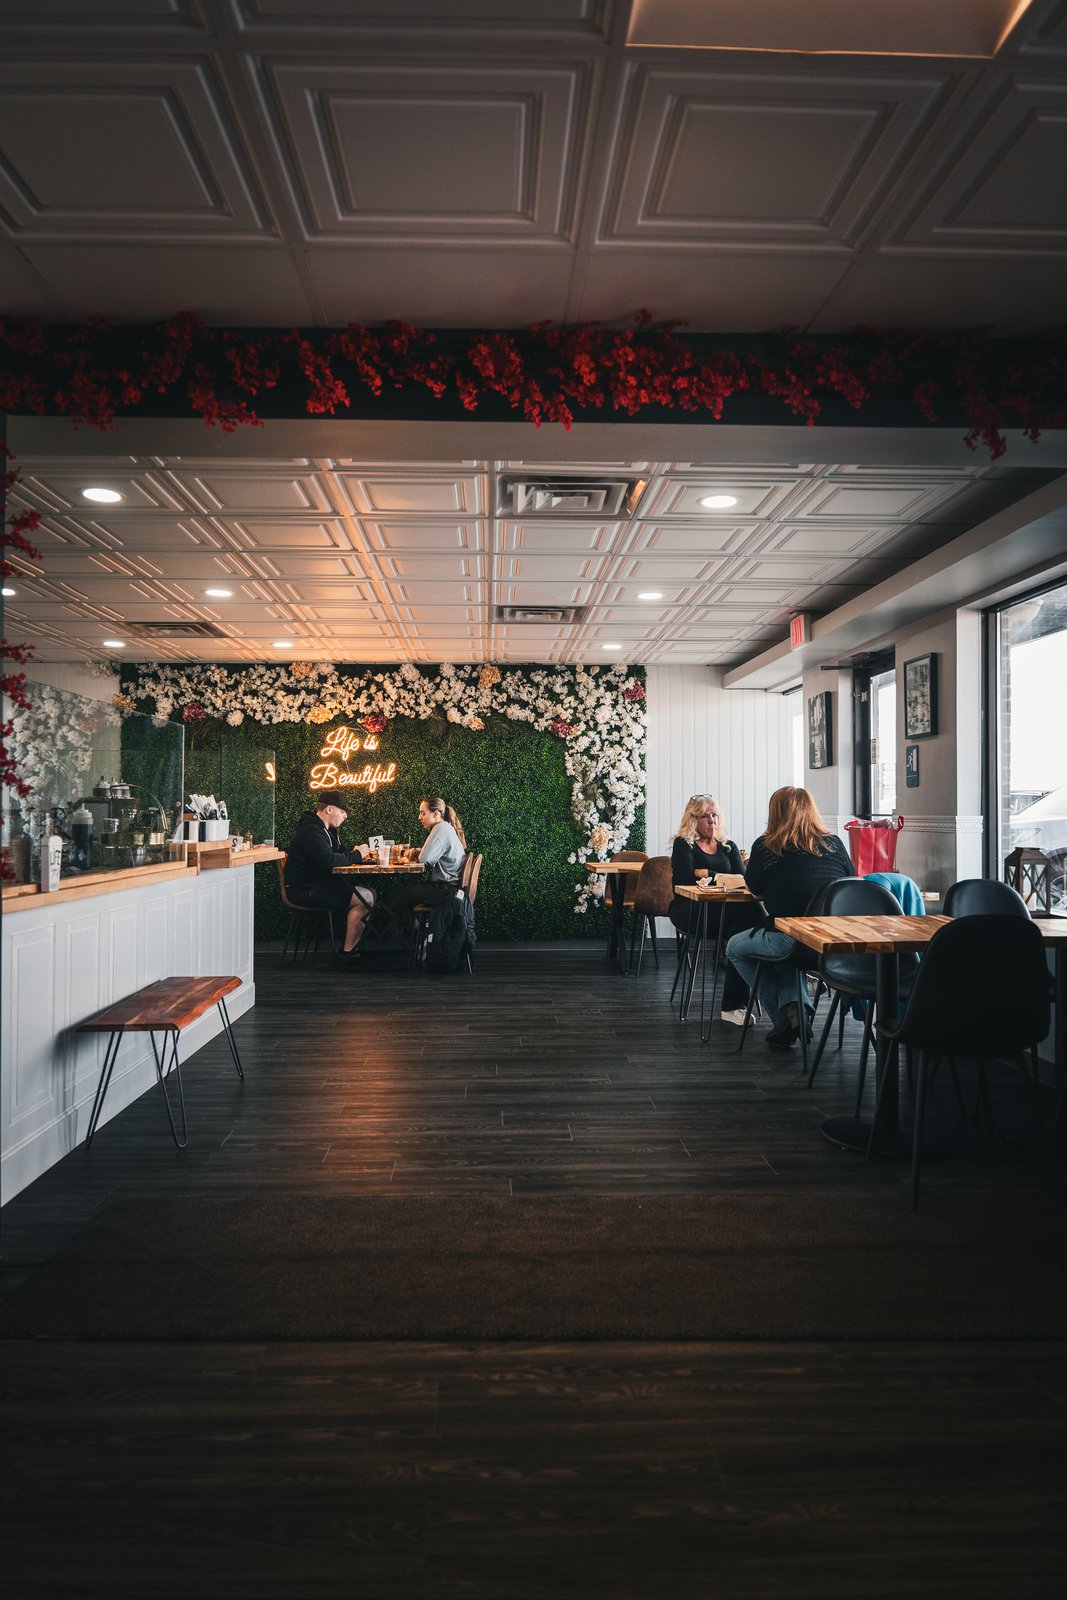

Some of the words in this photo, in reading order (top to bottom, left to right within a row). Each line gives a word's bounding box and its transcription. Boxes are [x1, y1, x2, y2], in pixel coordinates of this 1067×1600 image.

[320, 726, 360, 761] Life
[363, 734, 379, 751] is
[310, 762, 396, 793] Beautiful
[373, 838, 380, 848] 2
